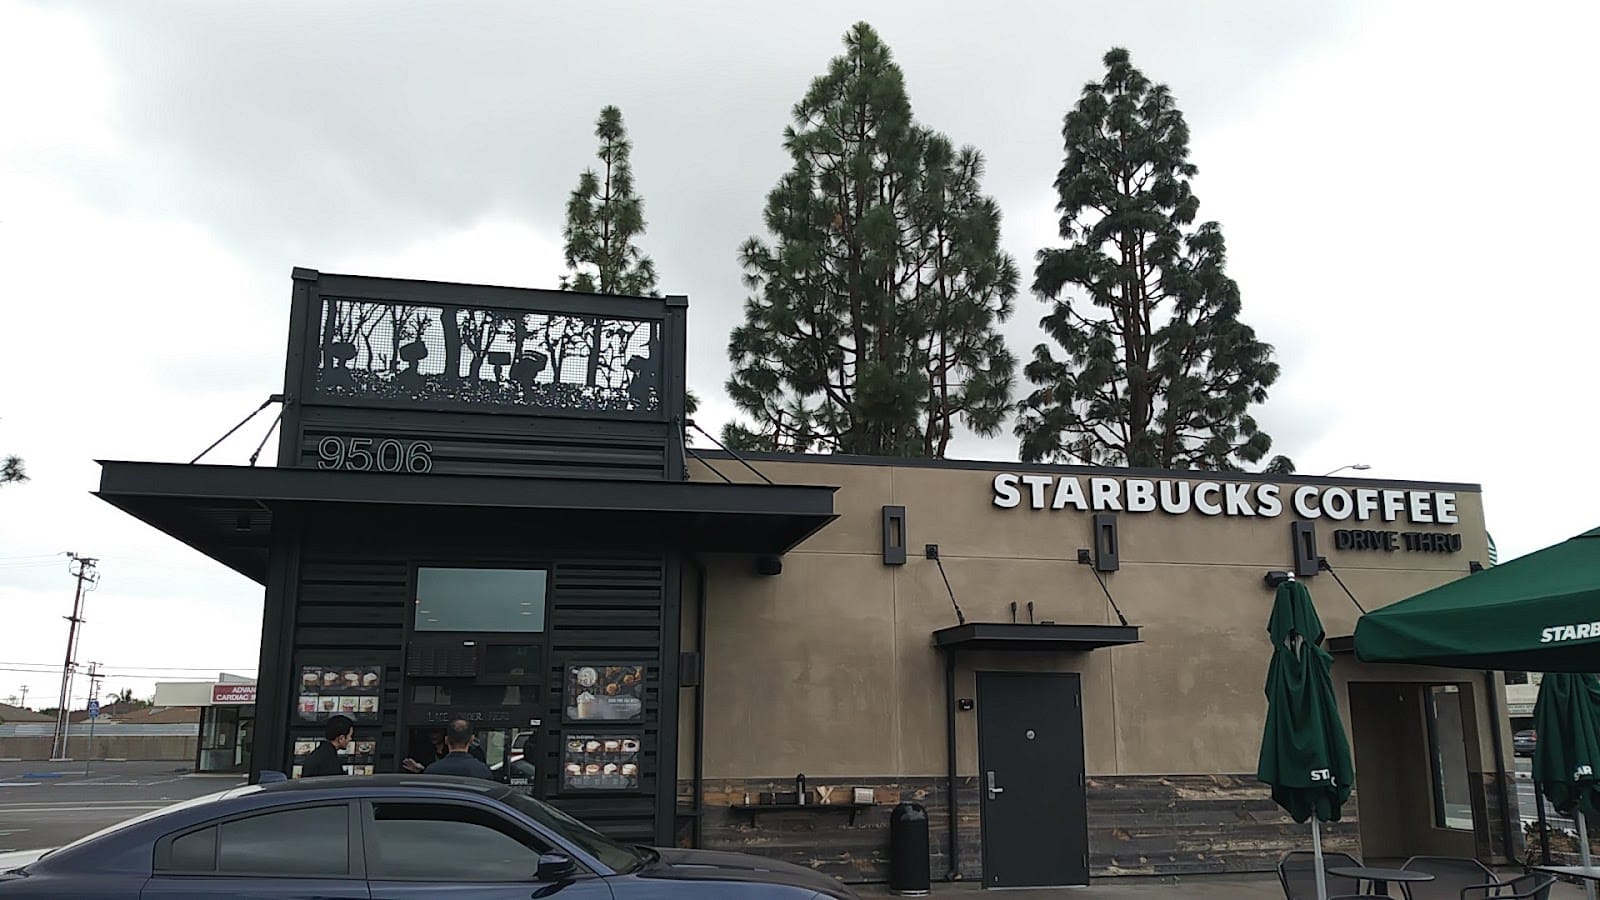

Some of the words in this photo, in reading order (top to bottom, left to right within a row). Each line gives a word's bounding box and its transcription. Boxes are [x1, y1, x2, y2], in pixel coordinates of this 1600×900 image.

[318, 436, 433, 473] 9506
[993, 473, 1283, 518] STARBUCKS
[1294, 485, 1459, 524] COFFEE
[1334, 529, 1400, 551] DRIVE
[1400, 532, 1462, 552] THRU
[1540, 621, 1600, 643] STARB
